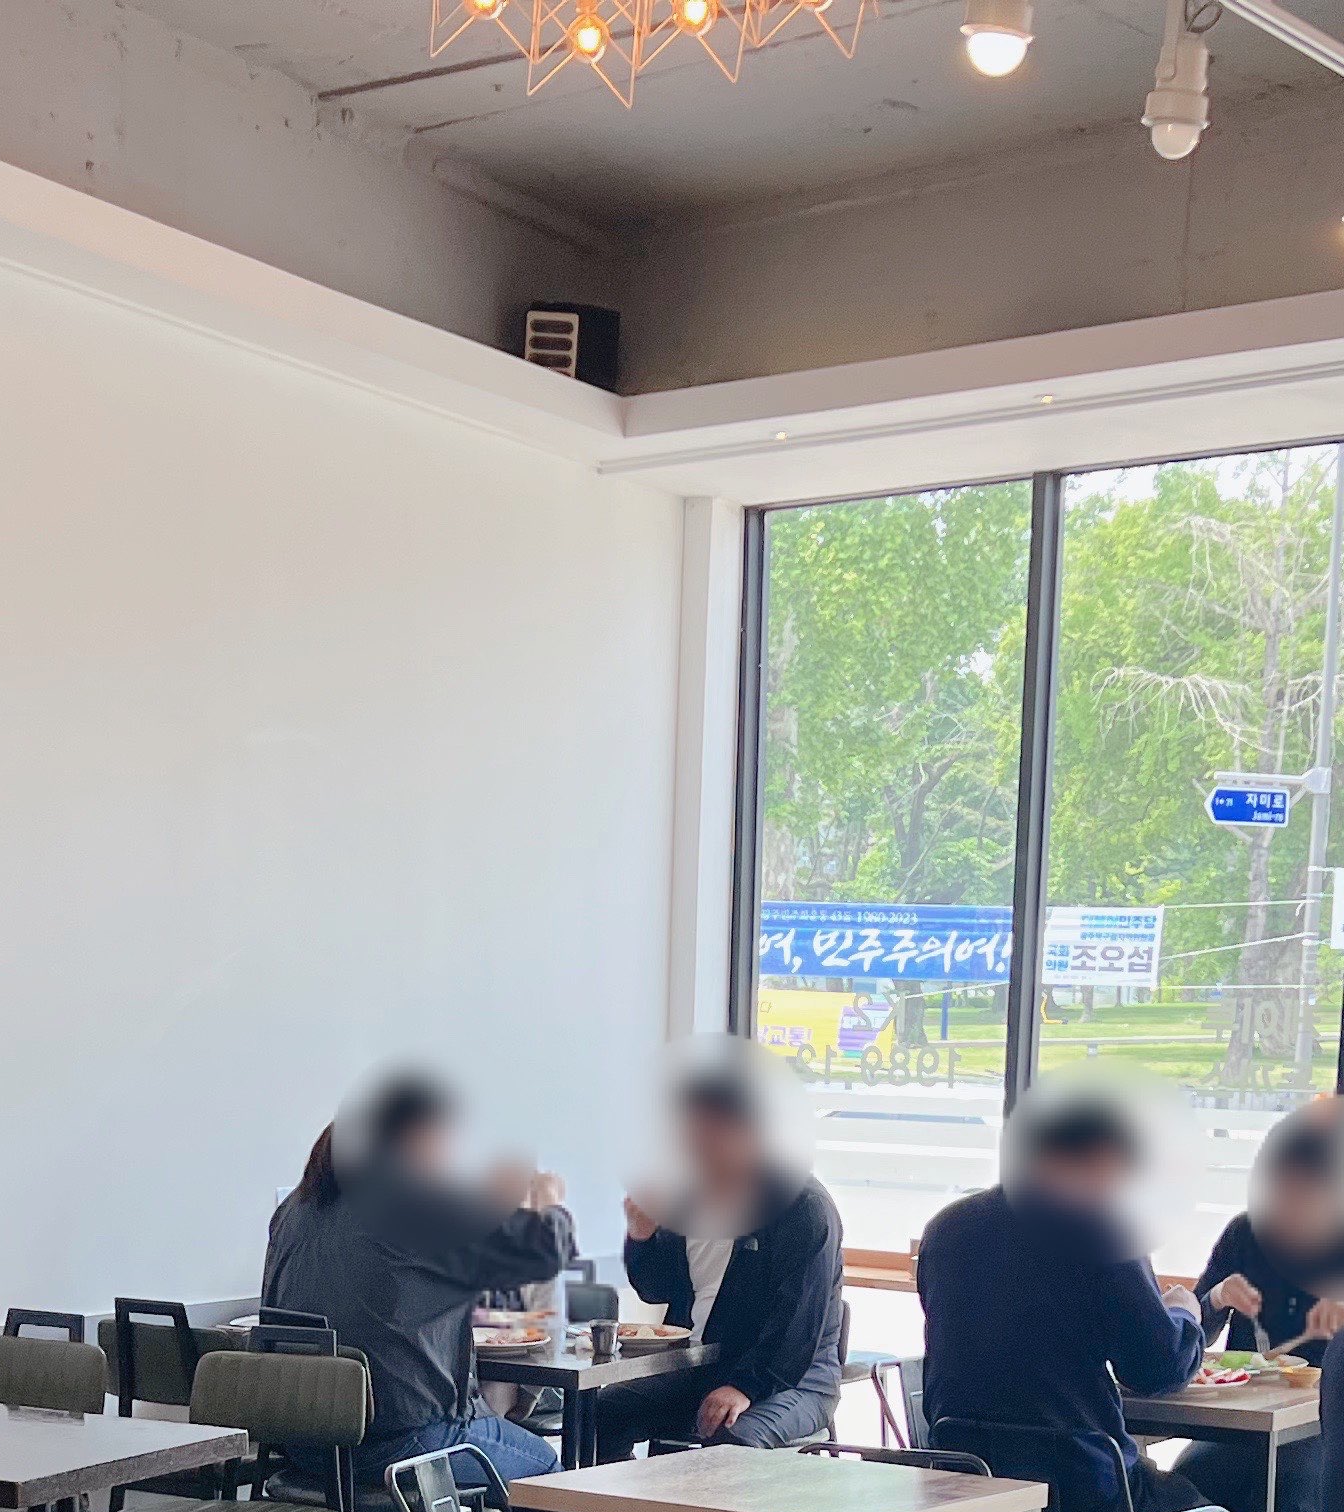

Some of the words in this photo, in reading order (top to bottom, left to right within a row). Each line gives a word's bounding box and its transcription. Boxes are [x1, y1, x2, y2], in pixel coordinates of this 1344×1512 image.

[1245, 793, 1285, 809] 자미로
[812, 928, 1013, 974] 민주주의여!
[1070, 945, 1154, 973] 조오섭
